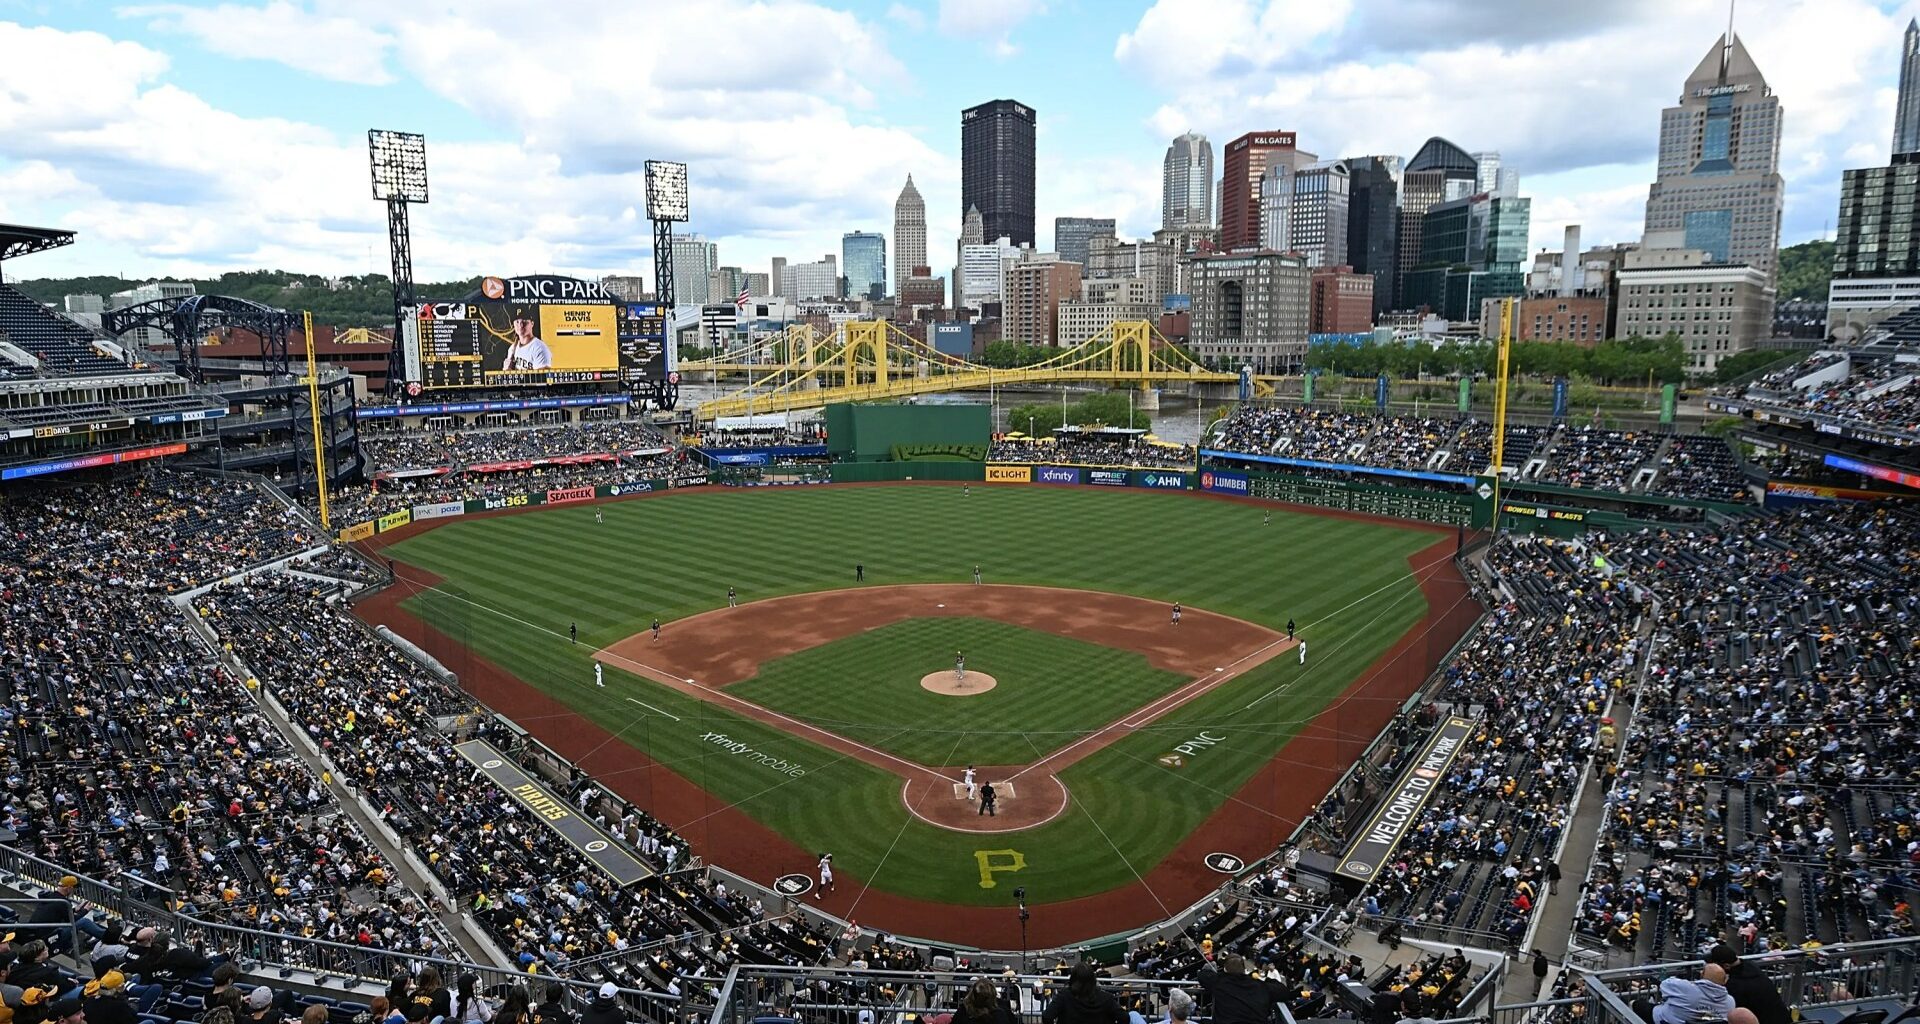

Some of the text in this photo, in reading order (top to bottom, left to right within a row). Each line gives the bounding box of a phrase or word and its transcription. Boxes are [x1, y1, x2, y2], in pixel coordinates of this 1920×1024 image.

[508, 280, 611, 299] PNC PARK
[989, 470, 1027, 478] IC LIGHT
[1043, 470, 1074, 482] xfinity
[620, 483, 652, 492] VANDA
[678, 477, 707, 487] BETMGM
[1157, 477, 1181, 487] AHN
[1202, 475, 1247, 490] 84 LUMBER
[485, 495, 528, 509] bet365
[550, 489, 592, 502] SEATGEEK
[440, 505, 461, 514] paze
[1507, 505, 1536, 515] BOWSER
[1554, 511, 1583, 521] BLASTS
[1172, 731, 1227, 756] PNC
[700, 731, 805, 777] xfinity mobile
[1366, 736, 1459, 846] WELCOME TO PNC PARK
[513, 784, 569, 821] PIRATES
[974, 849, 1028, 889] P
